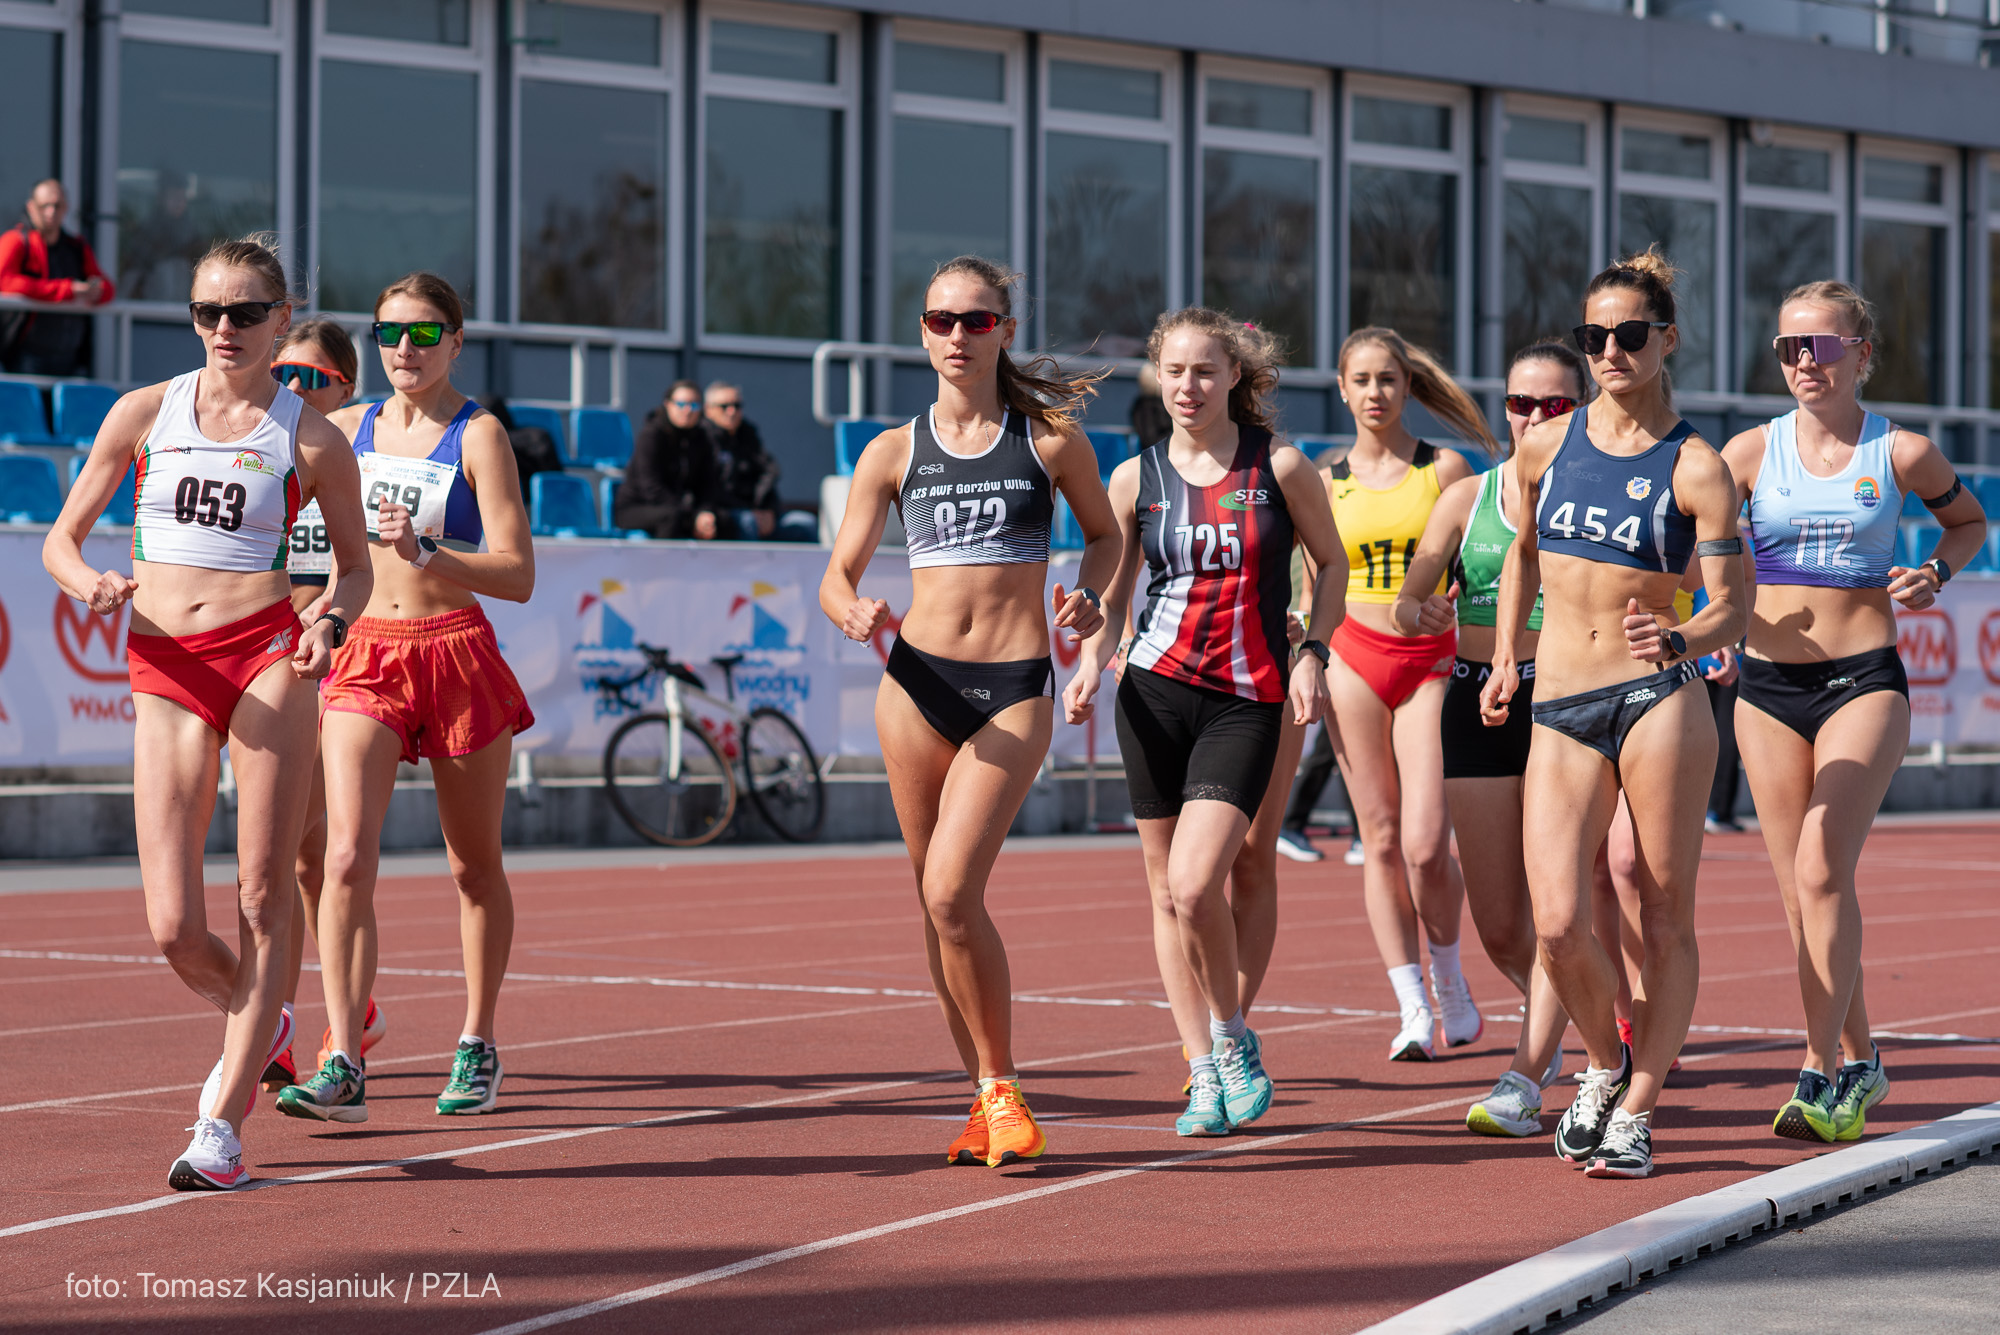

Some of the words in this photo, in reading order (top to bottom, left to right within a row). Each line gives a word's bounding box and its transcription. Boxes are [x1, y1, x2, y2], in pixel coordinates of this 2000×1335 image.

[916, 463, 945, 475] esa
[366, 480, 423, 518] 619
[911, 487, 927, 501] AZS
[929, 484, 953, 497] AWF
[956, 479, 1001, 495] Gorzów
[1004, 478, 1035, 491] Wlkp.
[1234, 489, 1268, 501] STS
[174, 476, 247, 532] 053
[1149, 500, 1172, 513] esa
[933, 496, 1008, 551] 872
[1549, 501, 1642, 552] 454
[291, 524, 332, 553] 99
[1174, 523, 1242, 571] 725
[1789, 518, 1855, 567] 712
[1471, 596, 1492, 606] AZS
[266, 626, 294, 655] 4F
[961, 687, 991, 700] esa
[1827, 677, 1857, 690] esa
[1625, 691, 1657, 704] adidas
